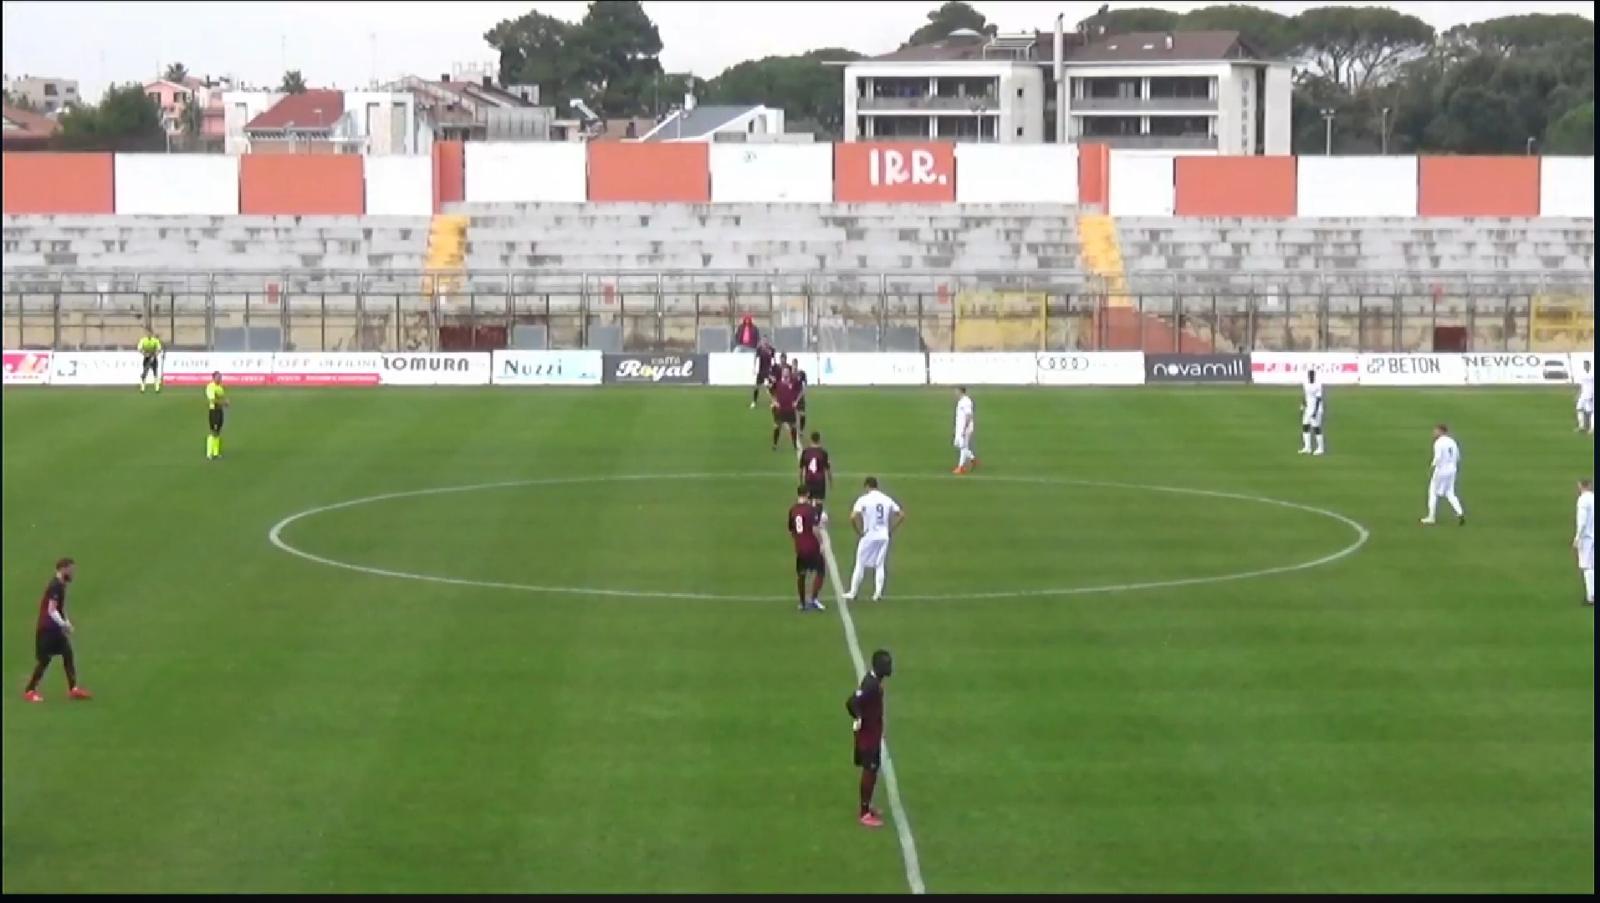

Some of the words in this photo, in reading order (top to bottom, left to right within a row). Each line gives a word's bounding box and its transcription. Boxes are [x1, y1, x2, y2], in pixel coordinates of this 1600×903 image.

[869, 148, 948, 186] IRR.
[504, 358, 562, 376] Nuzzi
[615, 359, 693, 381] Royal
[1153, 359, 1243, 377] novamill
[1388, 356, 1441, 374] BETON
[1463, 355, 1540, 368] NEWCO
[808, 458, 817, 473] 4
[876, 503, 884, 519] 9
